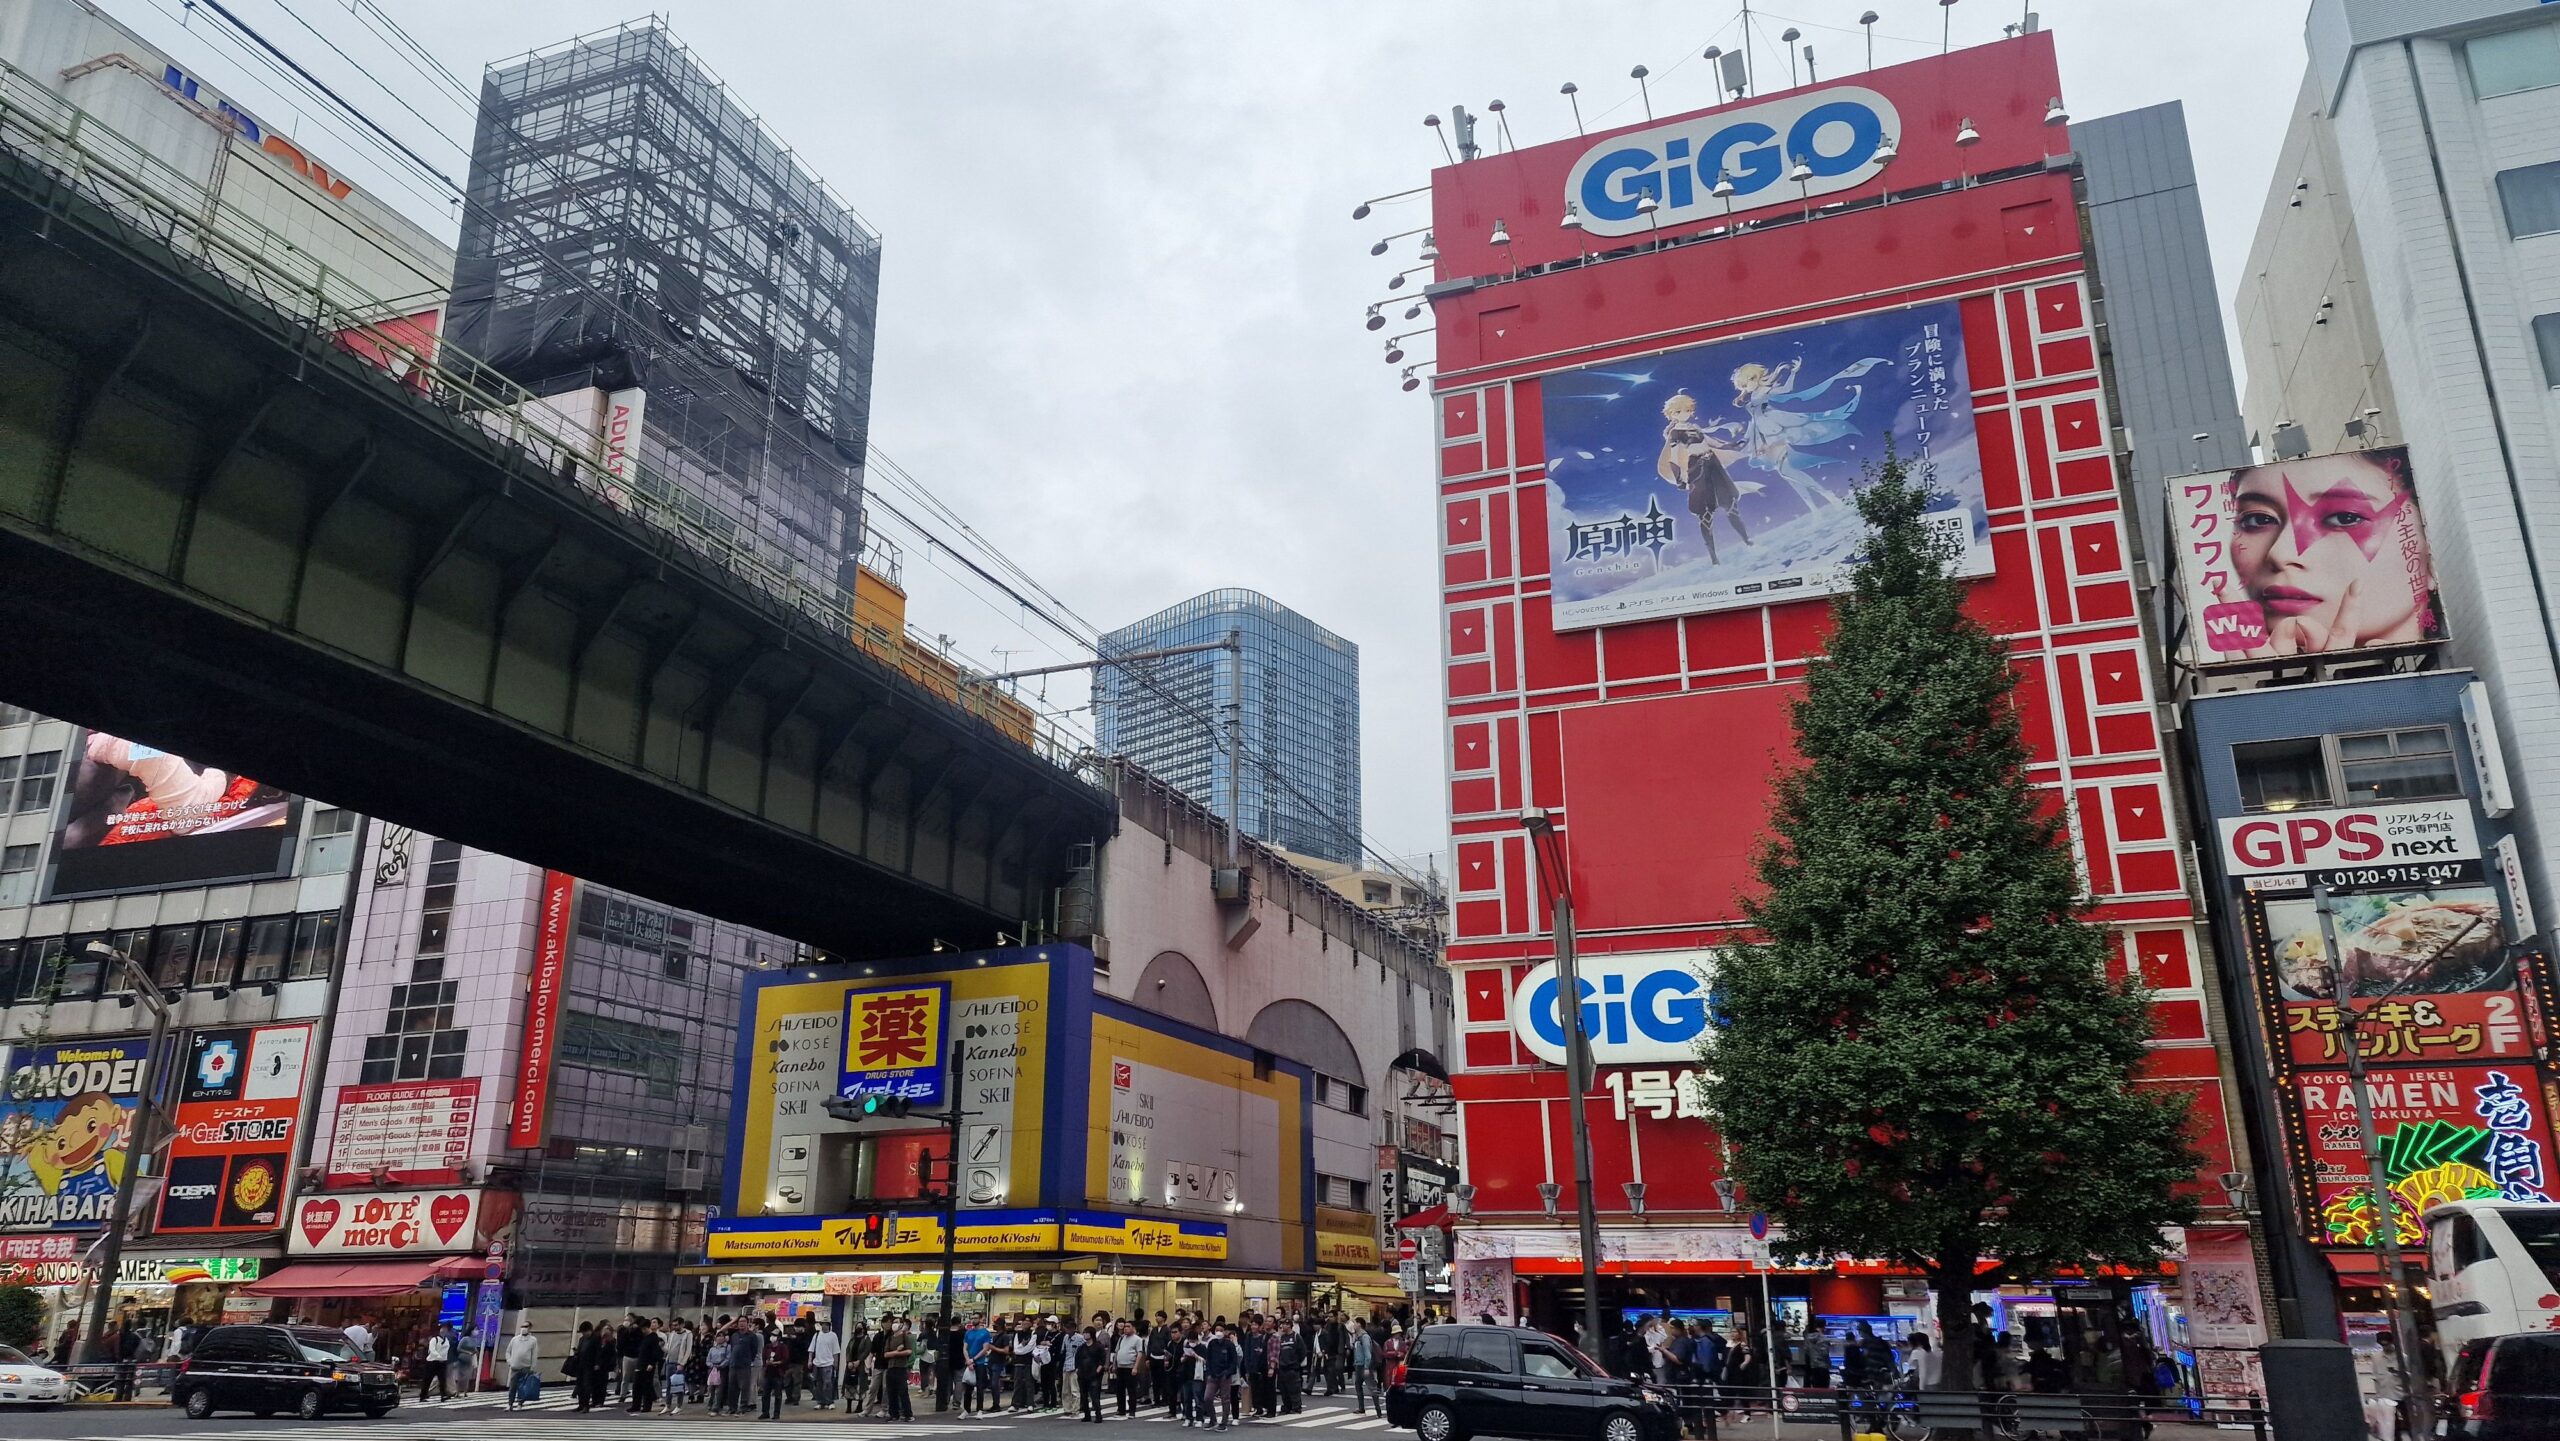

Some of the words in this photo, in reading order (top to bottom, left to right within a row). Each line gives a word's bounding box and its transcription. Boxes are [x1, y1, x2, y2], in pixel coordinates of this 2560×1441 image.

[1581, 101, 1883, 221] GiGO
[1923, 323, 1950, 411] 冒険に満ちた
[1565, 497, 1674, 573] 原神
[2184, 484, 2228, 596] ワクワク
[1574, 562, 1641, 577] Genshin
[1692, 589, 1729, 600] Windows
[106, 809, 164, 826] 戦争が始まって
[2385, 811, 2454, 824] リアルタイム
[2232, 813, 2385, 868] GPS
[2391, 835, 2459, 857] next
[2252, 877, 2299, 888] 当ビル4F
[2335, 864, 2462, 886] 0120-915-047
[519, 886, 563, 1134] www.akibalovemerci.com
[958, 1000, 1039, 1018] SHISEIDO
[1530, 970, 1732, 1047] GiG
[764, 1016, 838, 1032] SHISEIDO
[859, 994, 929, 1066] 薬
[991, 1019, 1032, 1036] KOSÉ
[195, 1036, 206, 1047] 5F
[793, 1035, 830, 1051] KOSÉ
[57, 1049, 109, 1063] Welcome
[111, 1047, 124, 1060] to
[965, 1042, 1027, 1061] Kanebo
[769, 1058, 825, 1074] Kanebo
[865, 1072, 887, 1080] DRUG
[889, 1070, 915, 1078] STORE
[969, 1067, 1023, 1082] SOFINA
[2301, 1073, 2396, 1084] YOKOMA
[2409, 1071, 2454, 1081] IEKEI
[192, 1089, 232, 1097] ENTAS
[366, 1091, 390, 1101] FLOOR
[392, 1090, 414, 1099] GUIDE
[771, 1080, 820, 1095] SOFINA
[980, 1087, 1010, 1104] SK-II
[2303, 1082, 2460, 1110] RAMEN
[213, 1106, 265, 1119] ジーストア
[343, 1105, 356, 1115] 4F
[361, 1105, 380, 1114] Men's
[382, 1104, 405, 1113] Goods
[779, 1100, 808, 1116] SK-II
[2333, 1109, 2435, 1120] ICHKAKUYA
[342, 1120, 353, 1130] 3F
[359, 1118, 379, 1127] Men's
[380, 1117, 403, 1126] Goods
[1114, 1109, 1154, 1129] SHISEIDO
[179, 1124, 192, 1138] 4F
[339, 1133, 350, 1144] 2F
[388, 1131, 411, 1140] Goods
[2319, 1124, 2363, 1141] ラーメン
[338, 1148, 349, 1158] 1F
[354, 1146, 385, 1156] Costume
[387, 1144, 418, 1154] Lingerie
[1126, 1136, 1147, 1150] KOSÉ
[1112, 1154, 1145, 1172] Kanebo
[169, 1184, 217, 1197] COSPA
[305, 1210, 334, 1223] 秋葉原
[352, 1195, 420, 1225] LOVE
[1382, 1171, 1396, 1249] オヤイデ電気
[724, 1240, 781, 1250] Matsumoto
[782, 1238, 820, 1249] KiYoshi
[936, 1235, 999, 1245] Mtsumoto
[1000, 1232, 1041, 1243] KiYoshi
[1071, 1233, 1104, 1245] Matsumoto
[1105, 1235, 1125, 1246] KiYoshi
[1179, 1241, 1205, 1251] Matsumoto
[6, 1239, 39, 1259] FREE
[41, 1237, 74, 1259] 免税
[852, 1281, 878, 1293] SALE
